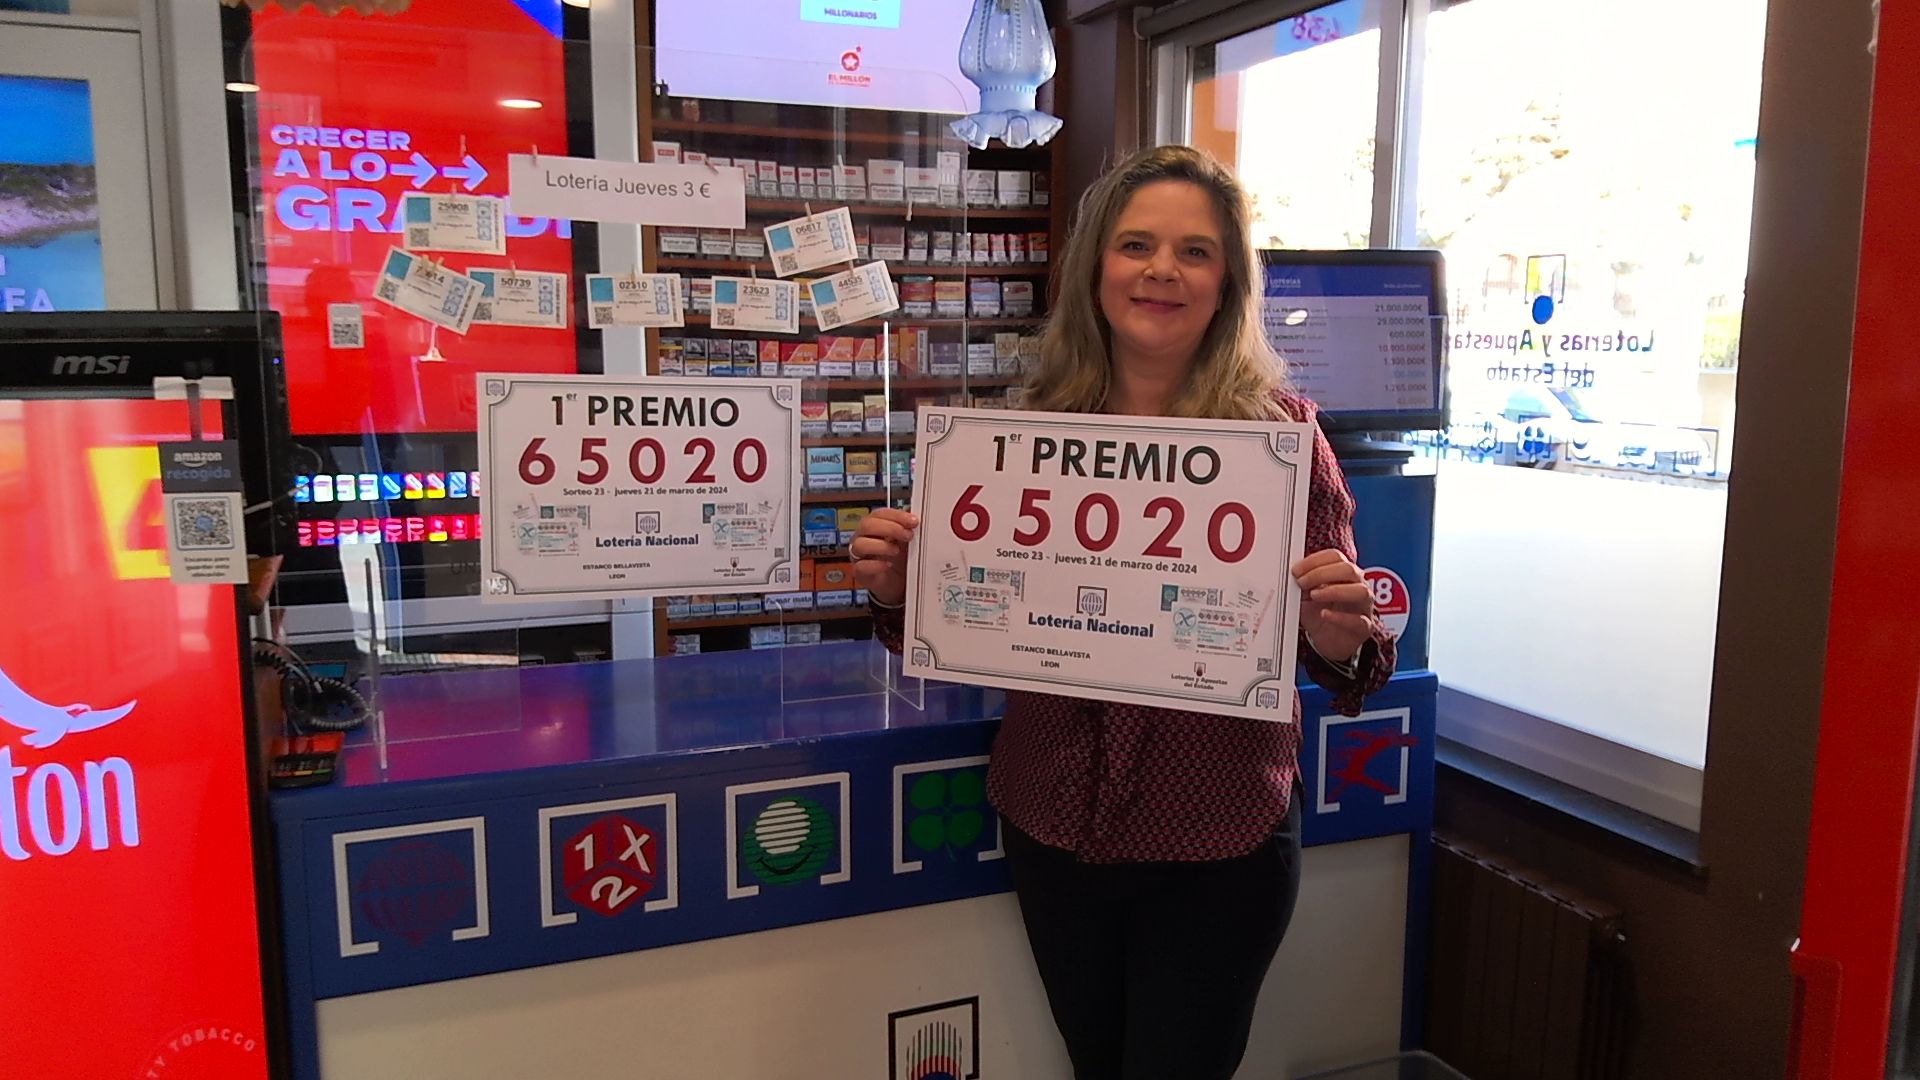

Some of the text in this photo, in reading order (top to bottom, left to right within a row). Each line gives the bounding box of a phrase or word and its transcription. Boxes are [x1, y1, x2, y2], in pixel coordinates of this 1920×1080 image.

[824, 8, 877, 20] MILLONARIOS
[271, 124, 411, 151] CRECER
[274, 149, 387, 183] A LO
[614, 177, 678, 197] Jueves
[683, 181, 695, 197] 3
[699, 183, 711, 198] €
[796, 222, 821, 234] 06817
[501, 276, 531, 288] 50739
[742, 285, 770, 296] 23623
[52, 354, 131, 375] msi
[588, 396, 740, 427] PREMIO
[174, 451, 222, 462] amazon
[1032, 436, 1221, 485] PREMIO
[166, 466, 232, 482] recogida
[563, 487, 594, 497] Sorteo
[594, 487, 605, 496] 23
[614, 486, 642, 497] jueves
[644, 487, 654, 496] 21
[657, 486, 667, 495] de
[696, 486, 706, 494] de
[708, 486, 728, 495] 2024
[645, 533, 699, 547] Nacional
[996, 548, 1029, 560] Sorteo
[1031, 550, 1043, 560] 23
[1055, 553, 1087, 565] jueves
[1089, 556, 1102, 566] 21
[1105, 556, 1118, 567] de
[1120, 560, 1153, 570] marzo
[1155, 561, 1169, 571] de
[1171, 563, 1198, 574] 2024
[1028, 612, 1154, 638] Lotería Nacional
[1011, 644, 1091, 660] ESTANCO BELLAVISTA
[168, 1027, 256, 1053] TOBACCO
